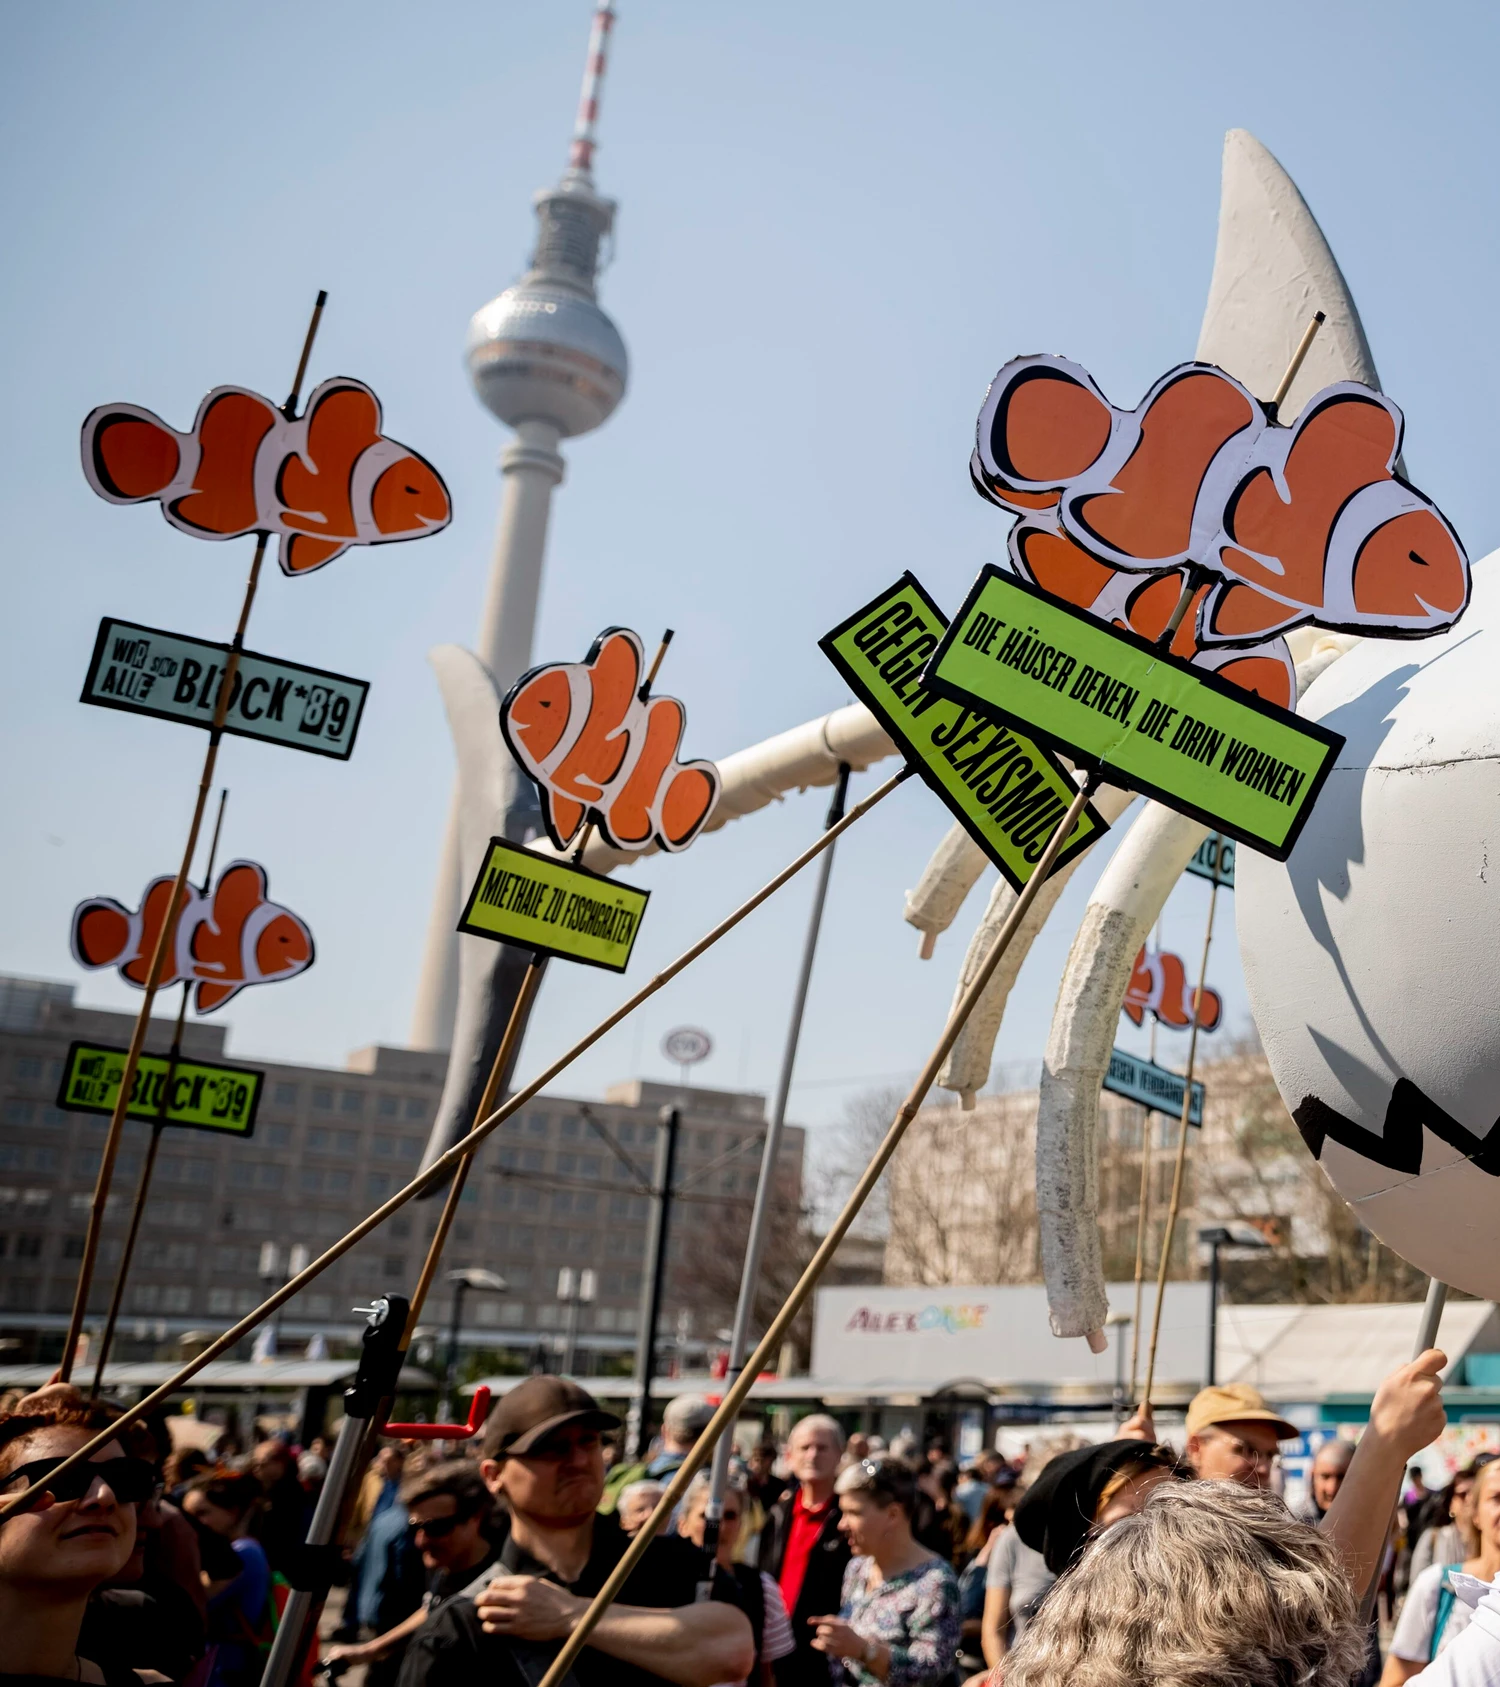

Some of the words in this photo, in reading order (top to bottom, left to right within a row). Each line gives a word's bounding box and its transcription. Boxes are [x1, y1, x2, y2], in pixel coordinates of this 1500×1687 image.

[101, 666, 156, 703] ALLE
[112, 638, 151, 669] WIR
[150, 657, 178, 678] SIND
[962, 611, 1006, 656] DIE
[996, 626, 1077, 693] HÄUSER
[1068, 664, 1140, 729] DENEN,
[1136, 698, 1178, 744] DIE
[1169, 714, 1226, 767] DRIN
[1219, 737, 1306, 807] WOHNEN
[931, 706, 1079, 865] SEXISMUS
[479, 867, 550, 919] MIETHAIE
[542, 886, 567, 925] ZU
[560, 892, 639, 946] FISCHGRÄTEN
